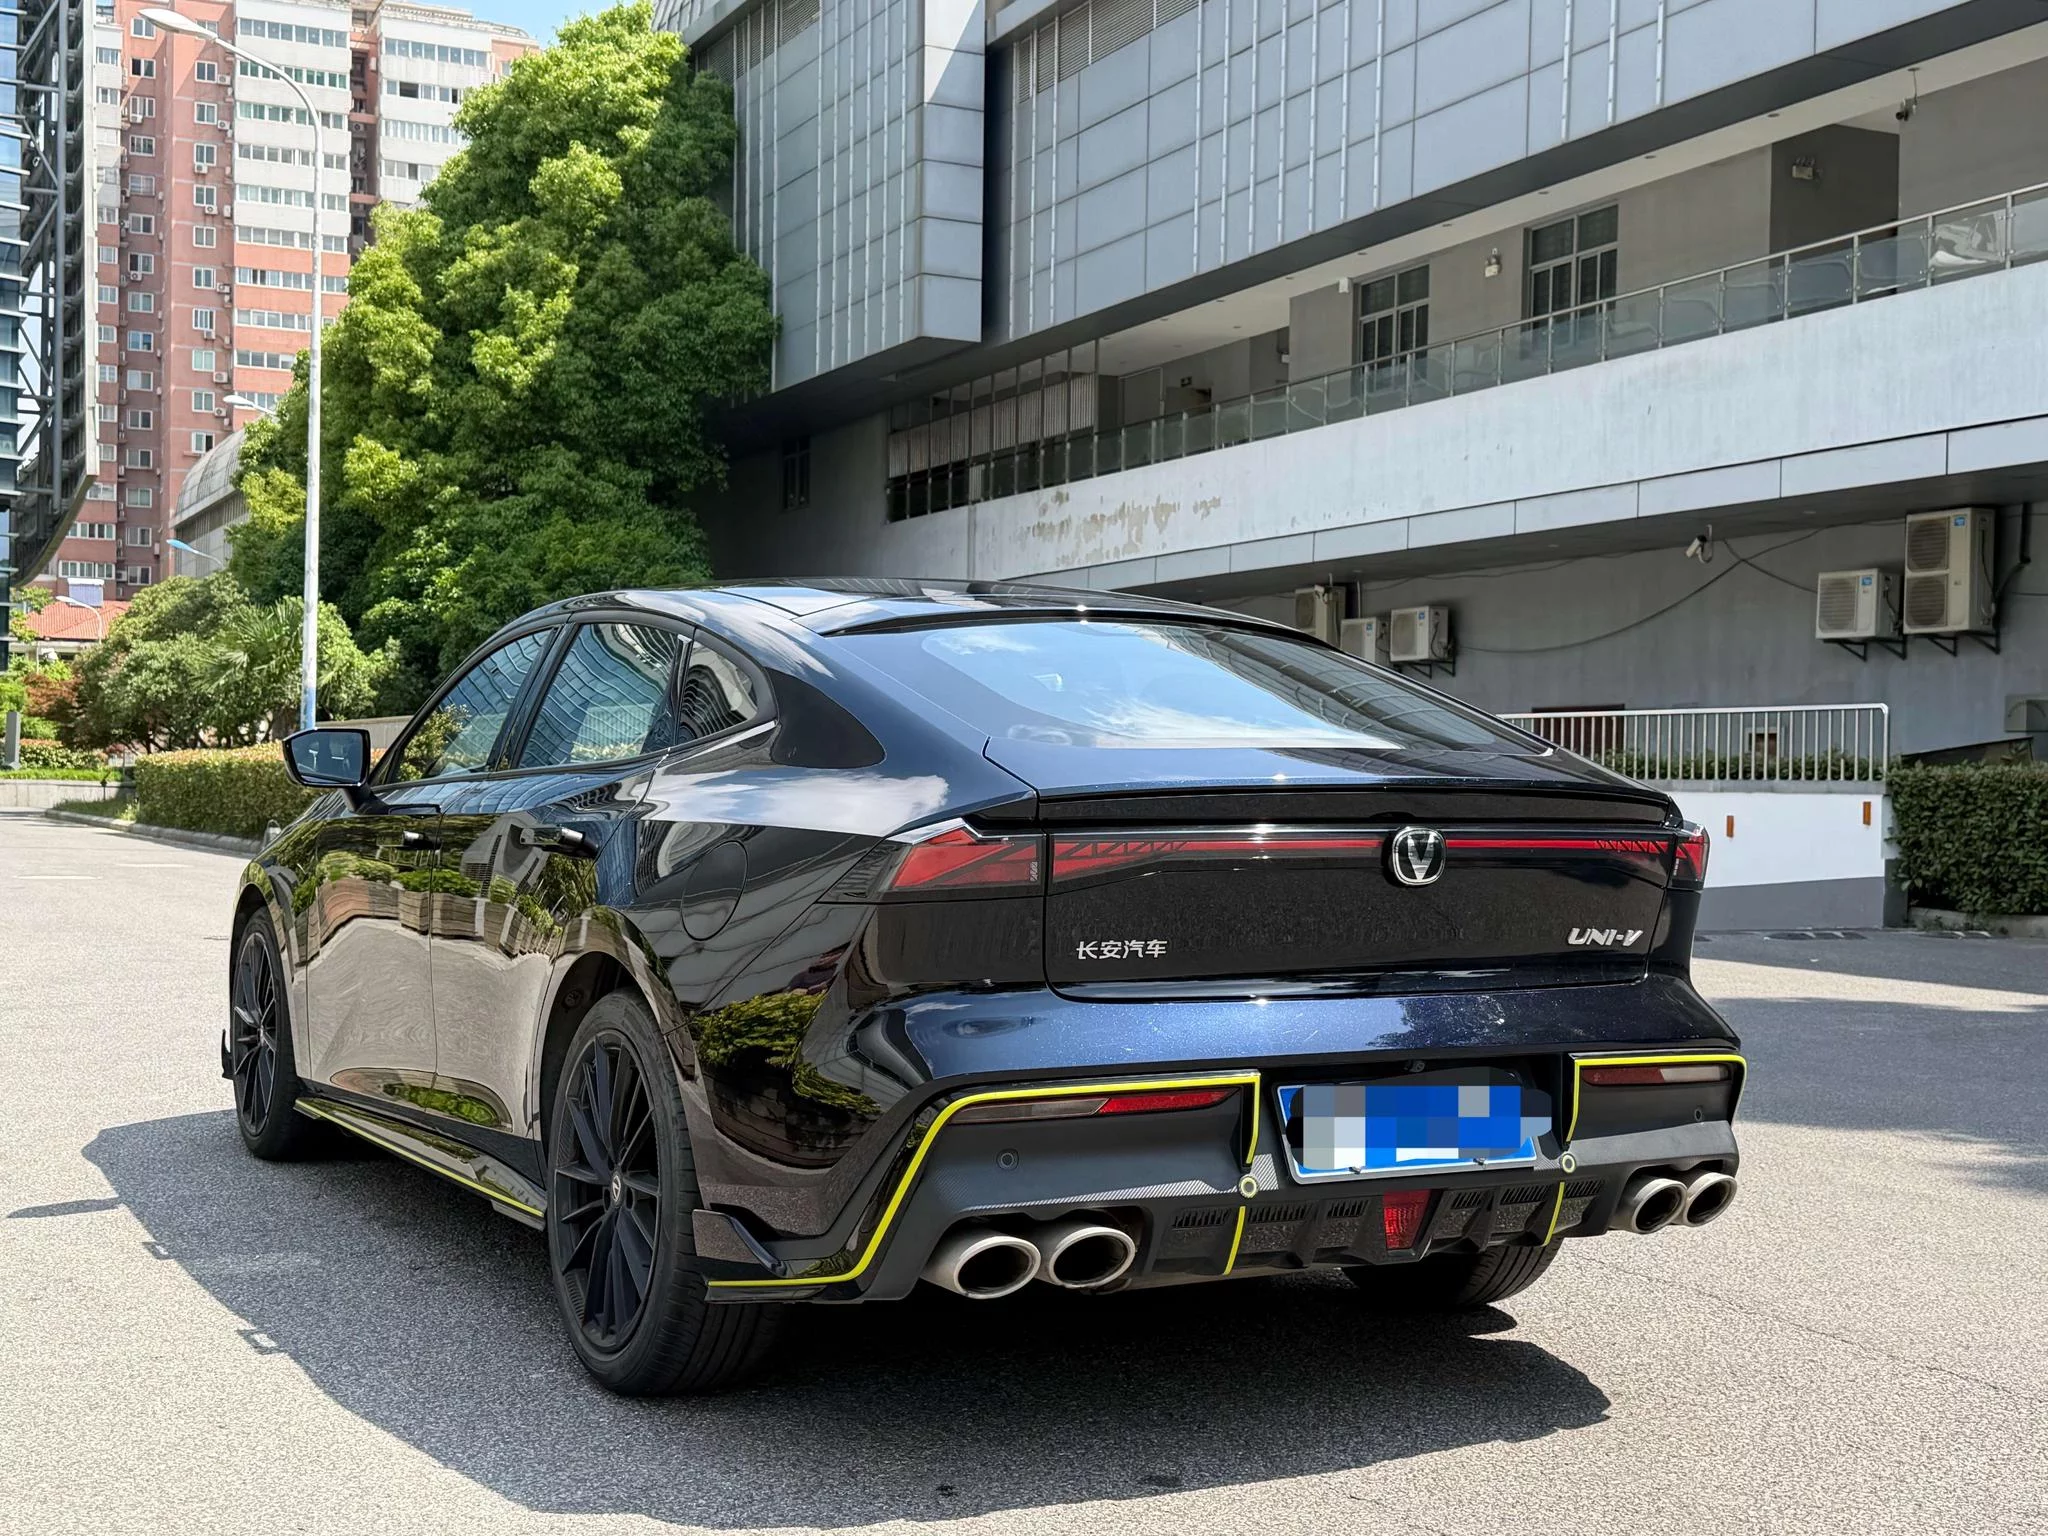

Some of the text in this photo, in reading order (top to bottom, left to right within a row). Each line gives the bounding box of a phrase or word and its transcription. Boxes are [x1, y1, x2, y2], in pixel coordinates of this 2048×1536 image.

[1568, 927, 1644, 947] UNI-V
[1076, 939, 1168, 960] 长安汽车
